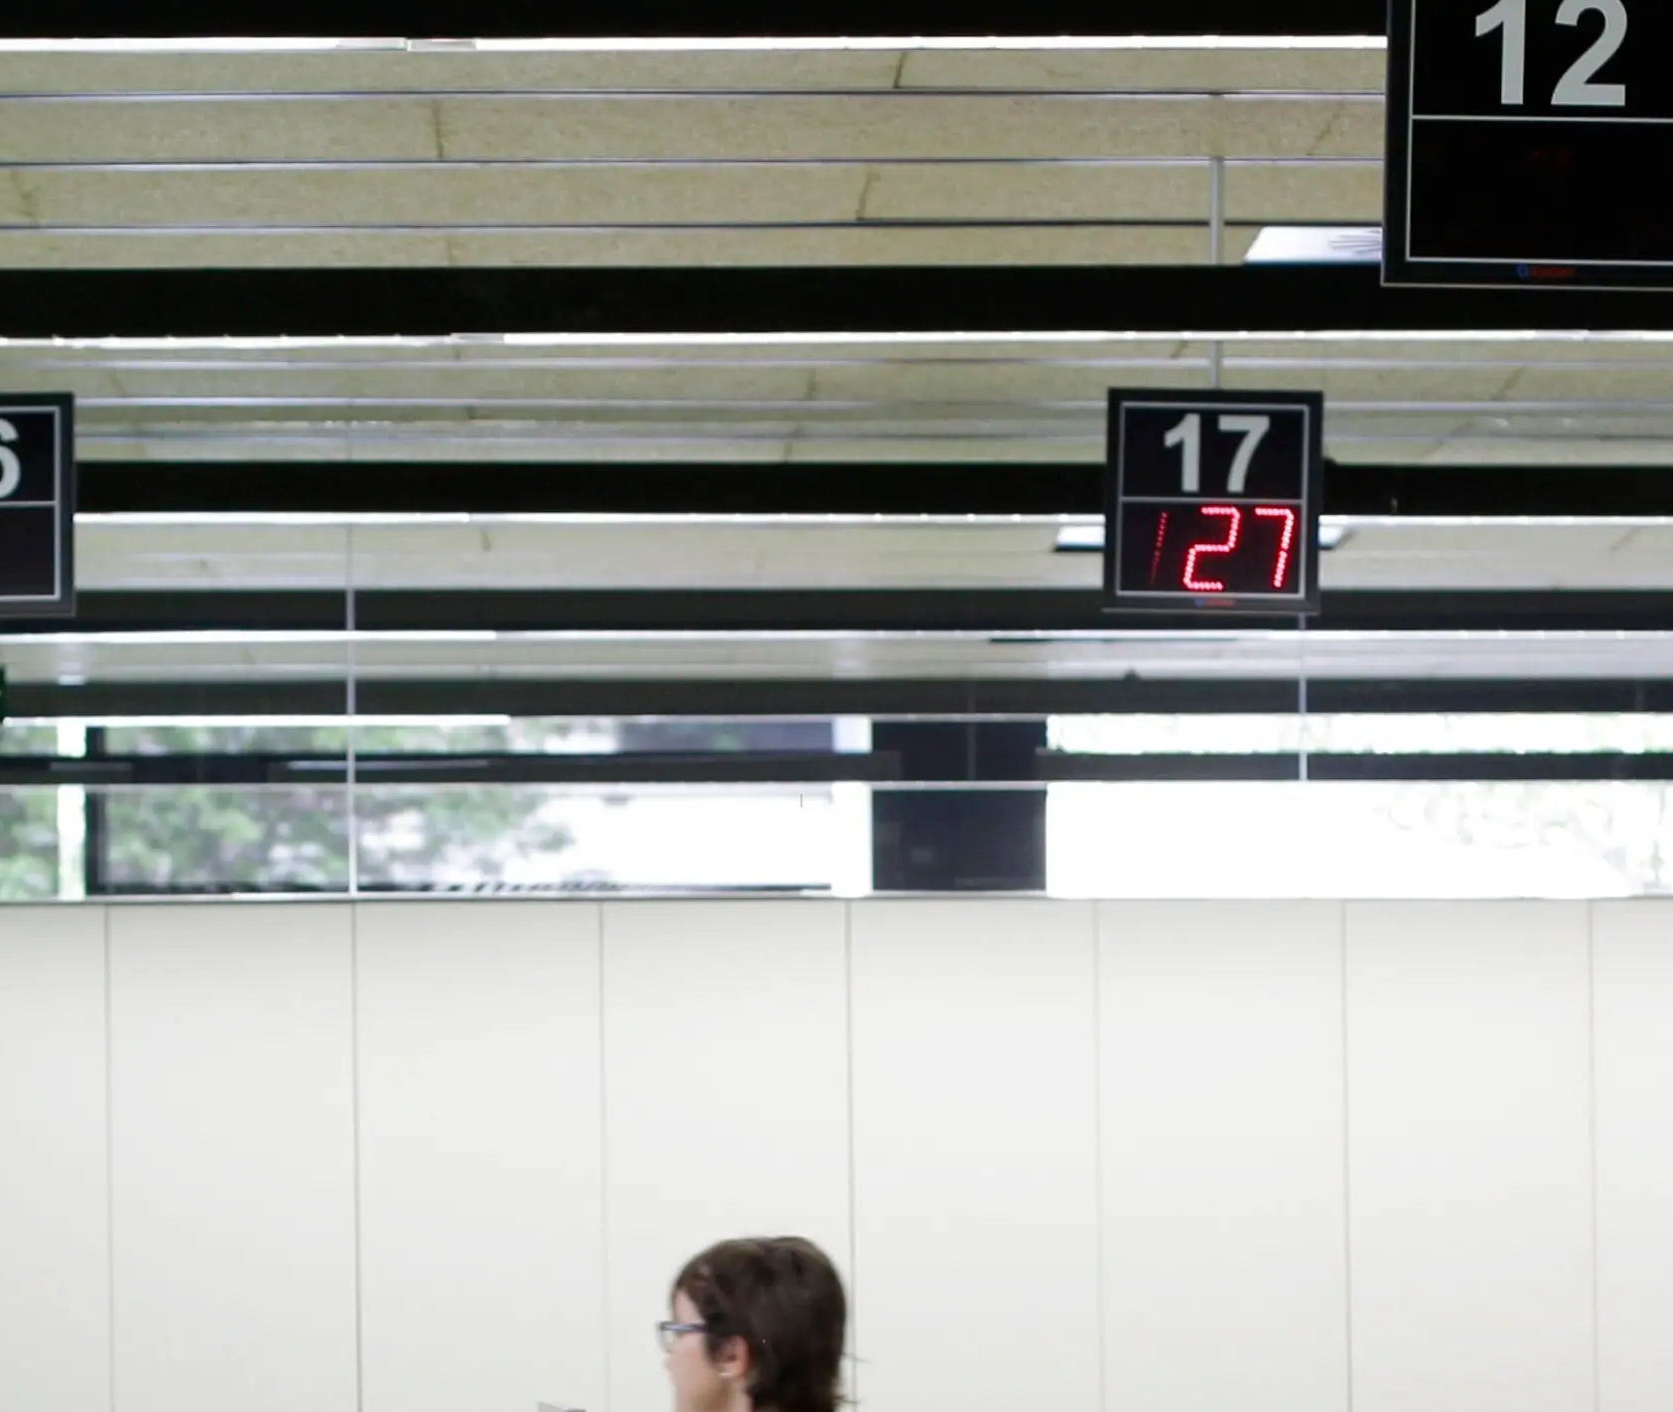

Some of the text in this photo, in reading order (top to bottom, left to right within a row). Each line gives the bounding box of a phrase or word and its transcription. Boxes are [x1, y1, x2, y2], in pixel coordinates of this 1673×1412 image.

[1475, 0, 1628, 106] 12
[1163, 412, 1271, 493] 17
[1149, 505, 1296, 591] 127
